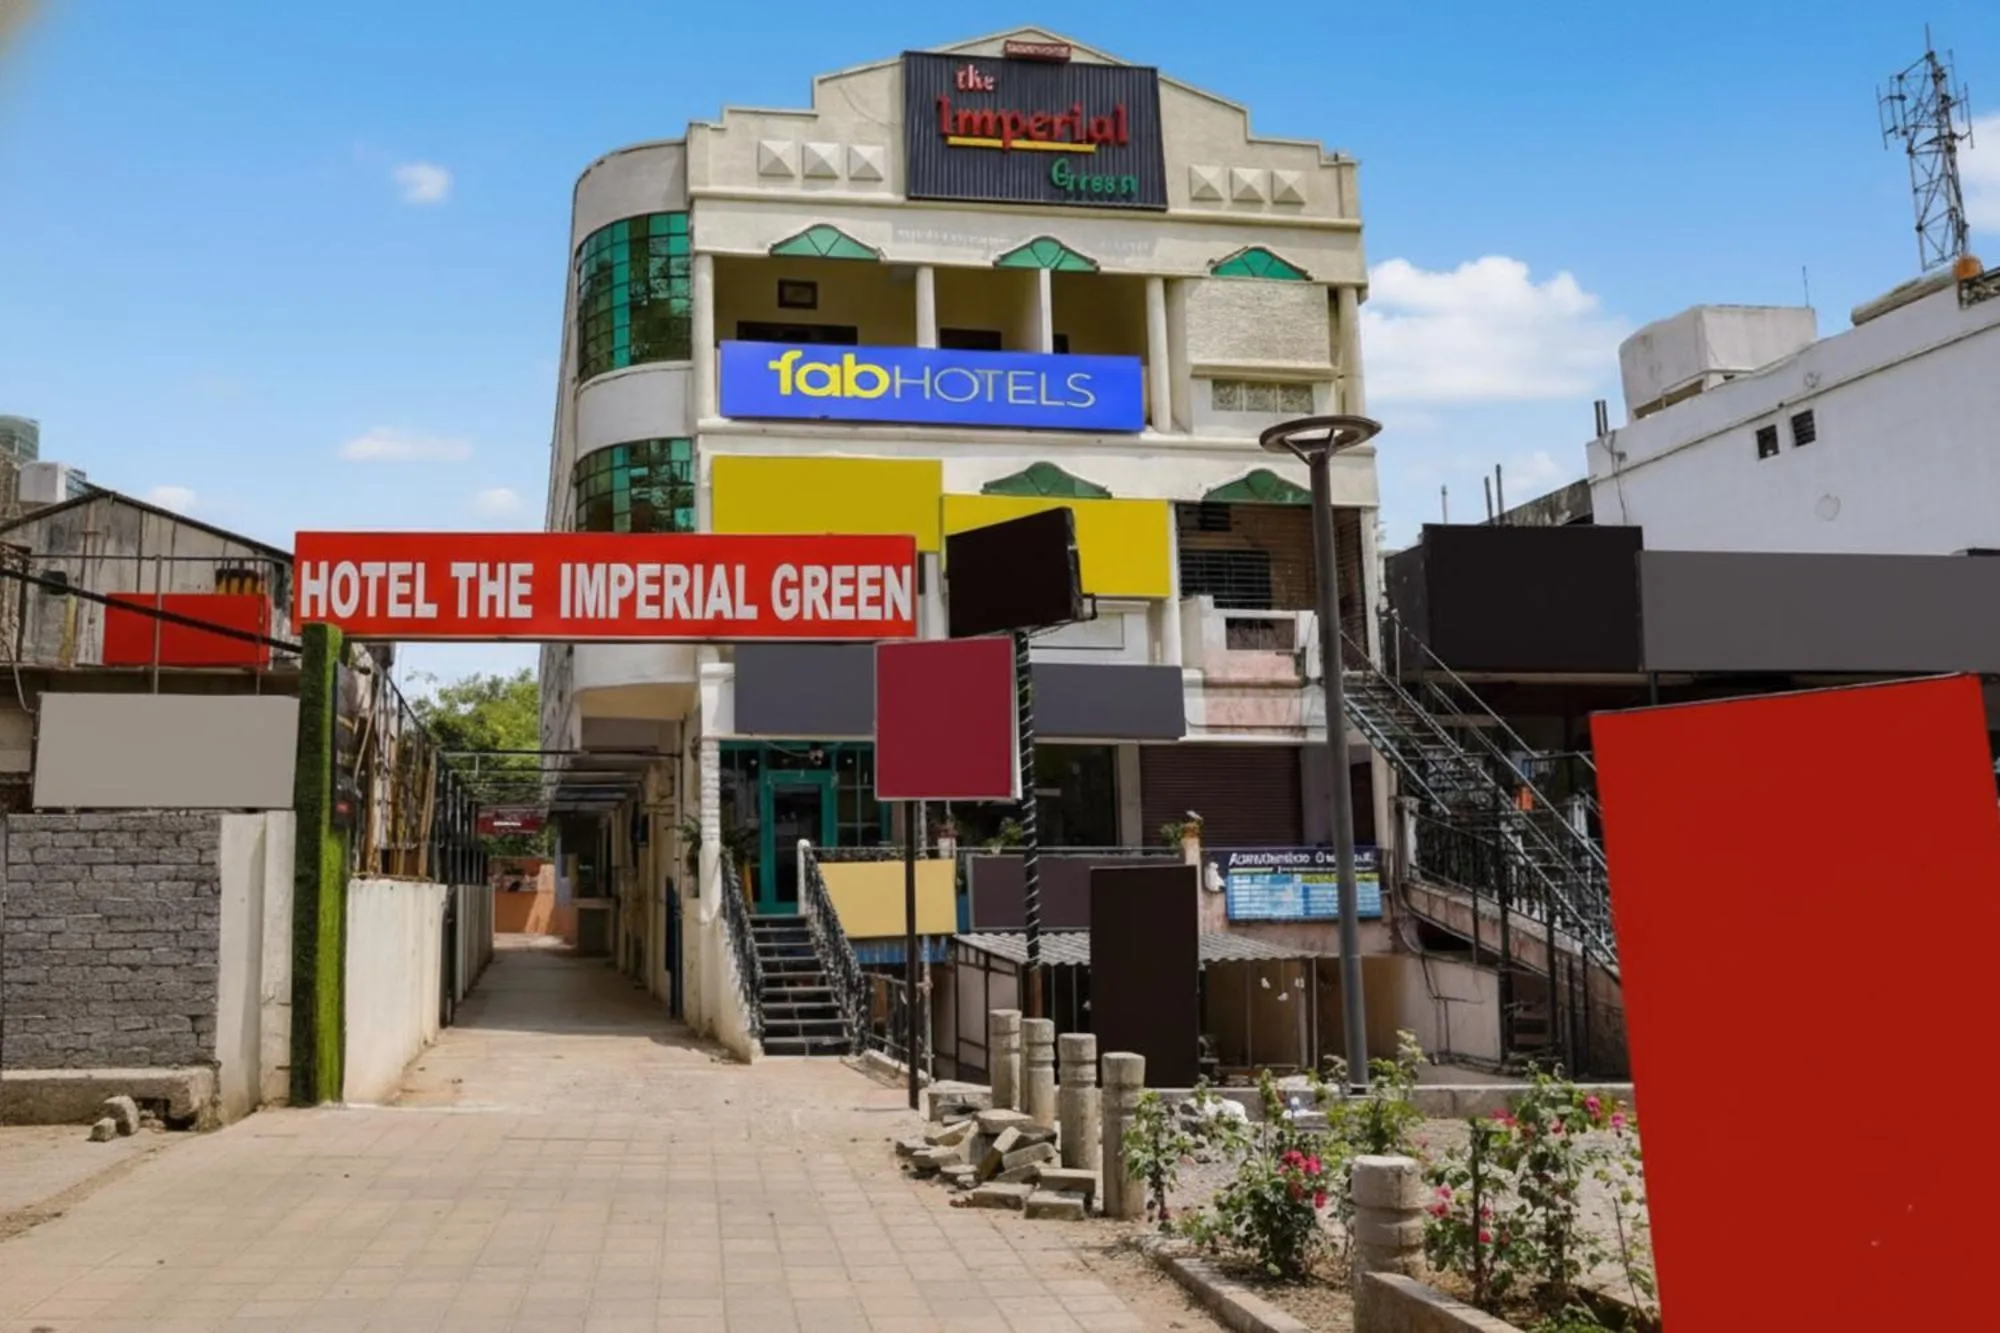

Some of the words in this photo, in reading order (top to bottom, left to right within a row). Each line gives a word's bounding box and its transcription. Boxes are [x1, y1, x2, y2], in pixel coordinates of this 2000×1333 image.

[955, 63, 996, 93] the
[937, 95, 1128, 149] Imperial
[1050, 157, 1137, 199] Green
[300, 560, 437, 618] HOTEL
[450, 561, 533, 618] THE
[560, 562, 758, 620] IMPERIAL
[771, 563, 912, 621] GREEN
